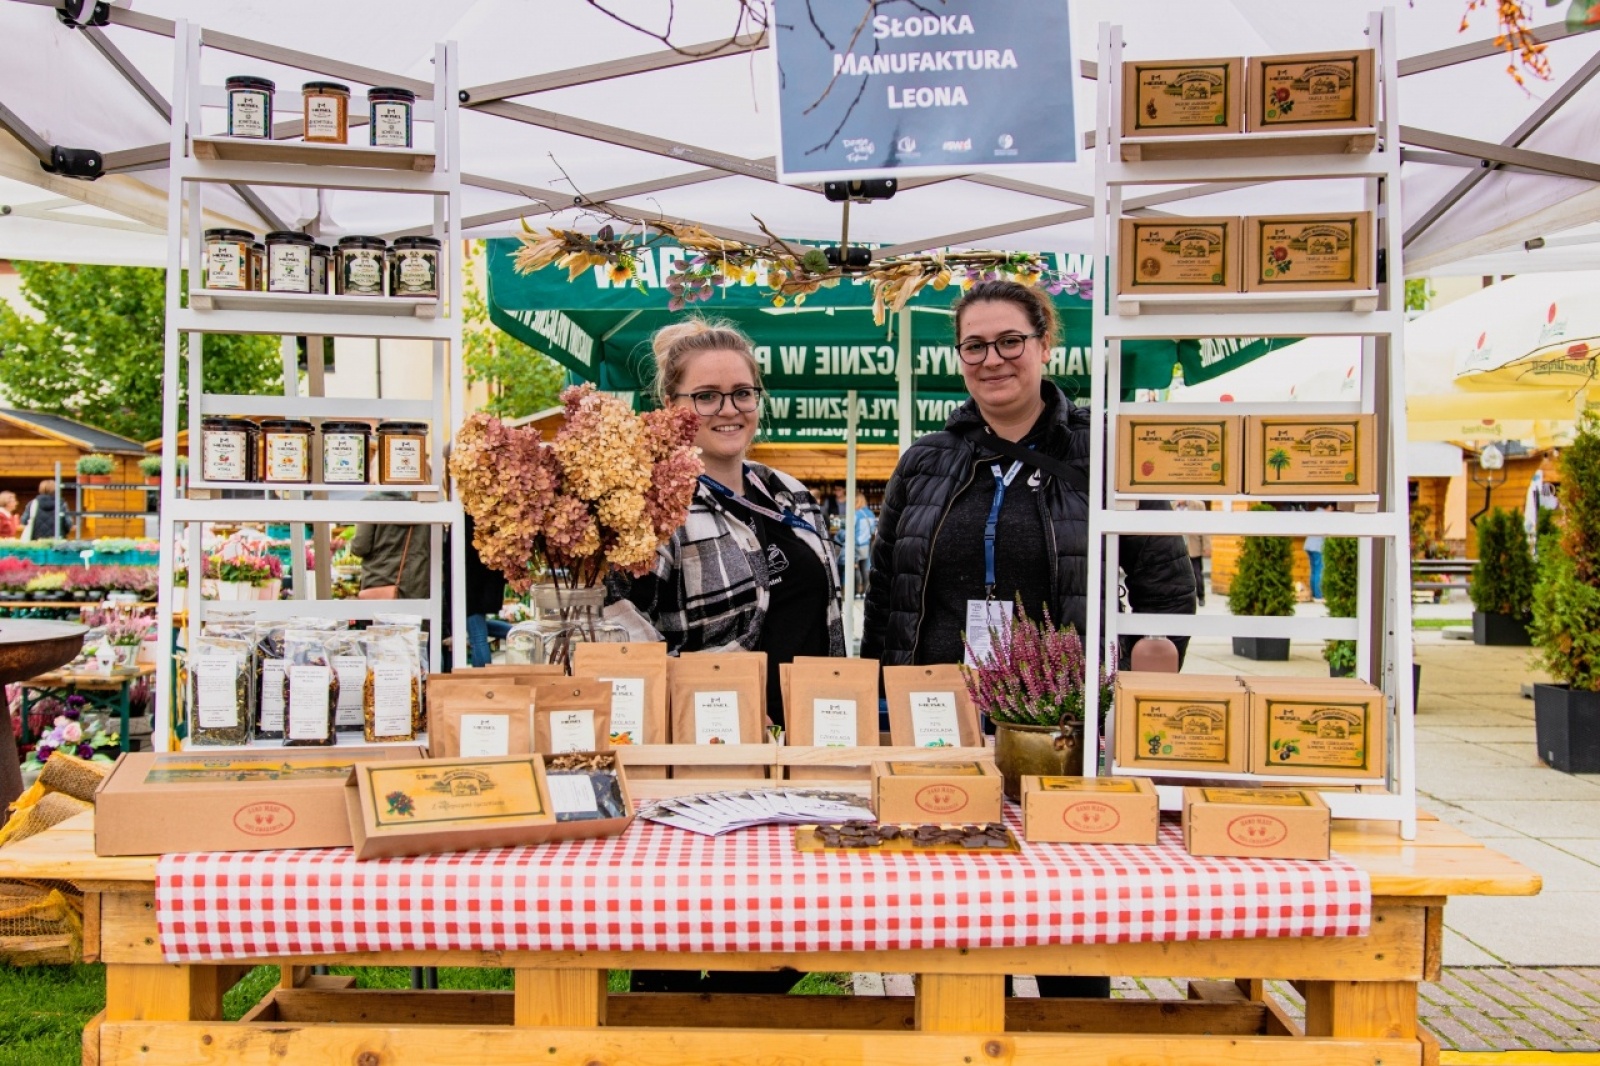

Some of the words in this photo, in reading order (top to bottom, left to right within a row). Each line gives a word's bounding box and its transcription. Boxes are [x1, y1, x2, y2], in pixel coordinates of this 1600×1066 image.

[873, 14, 974, 39] SŁODKA
[833, 49, 1018, 76] MANUFAKTURA
[887, 85, 968, 109] LEONA
